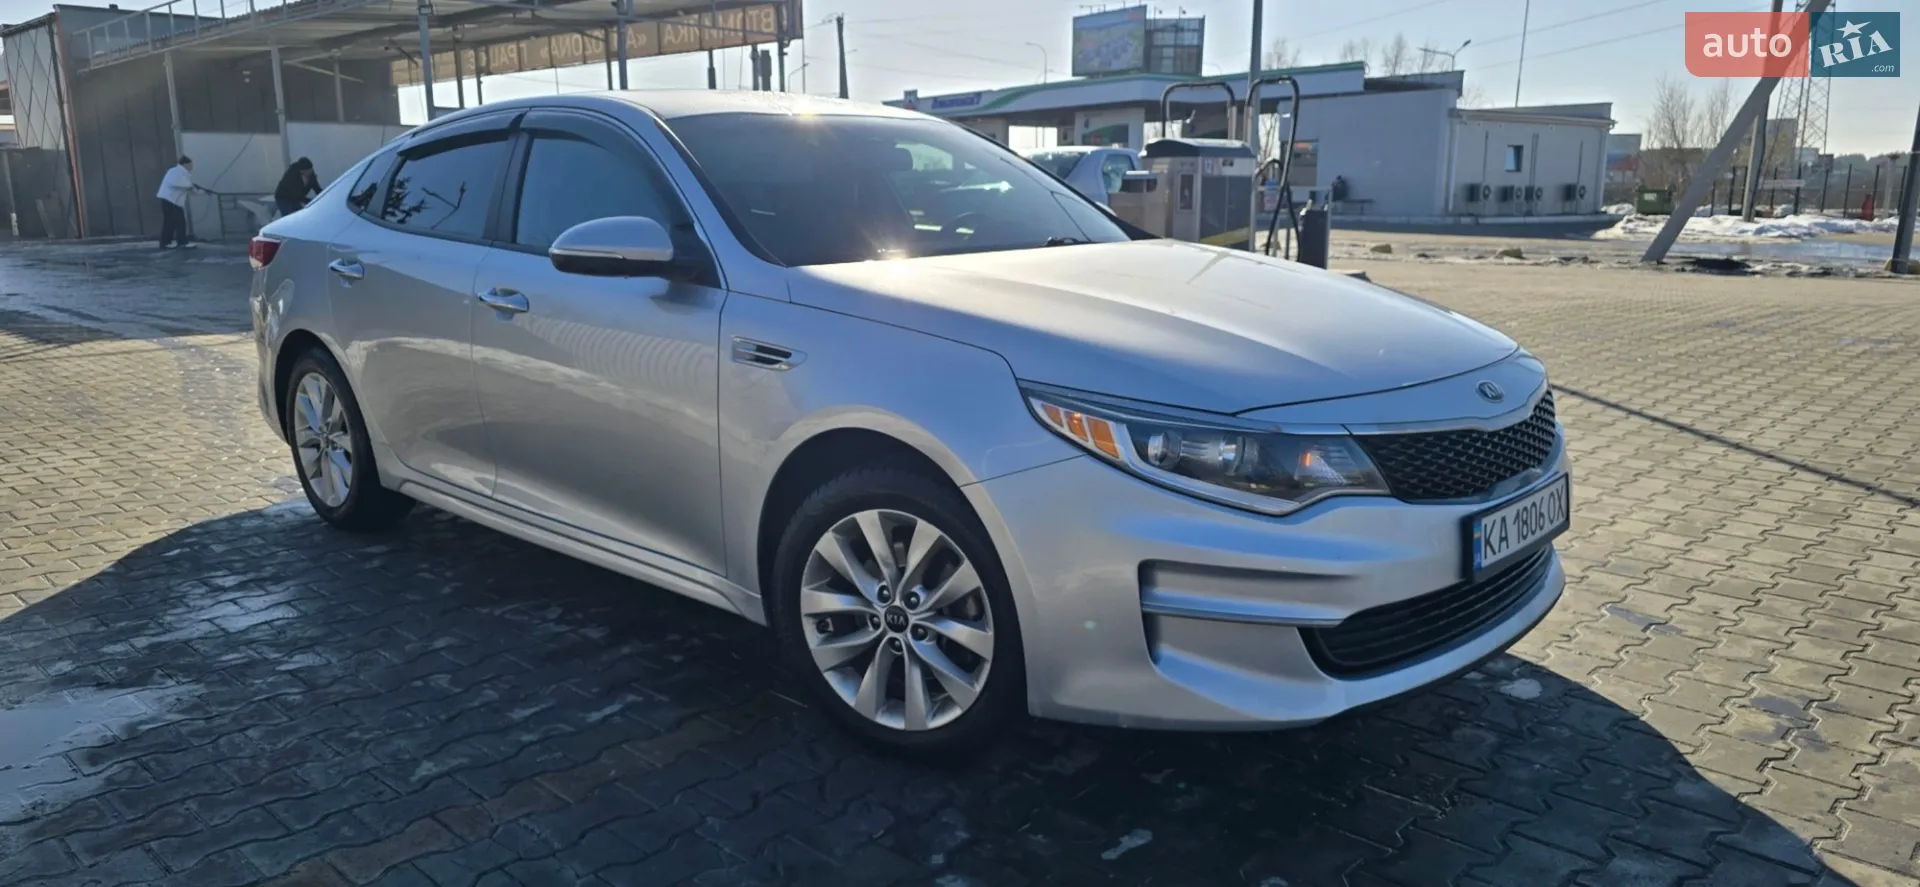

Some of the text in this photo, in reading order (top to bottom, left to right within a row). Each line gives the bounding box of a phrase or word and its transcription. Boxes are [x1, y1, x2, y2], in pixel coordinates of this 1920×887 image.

[1483, 484, 1565, 560] KA 1806 OX
[886, 613, 906, 626] KIA
